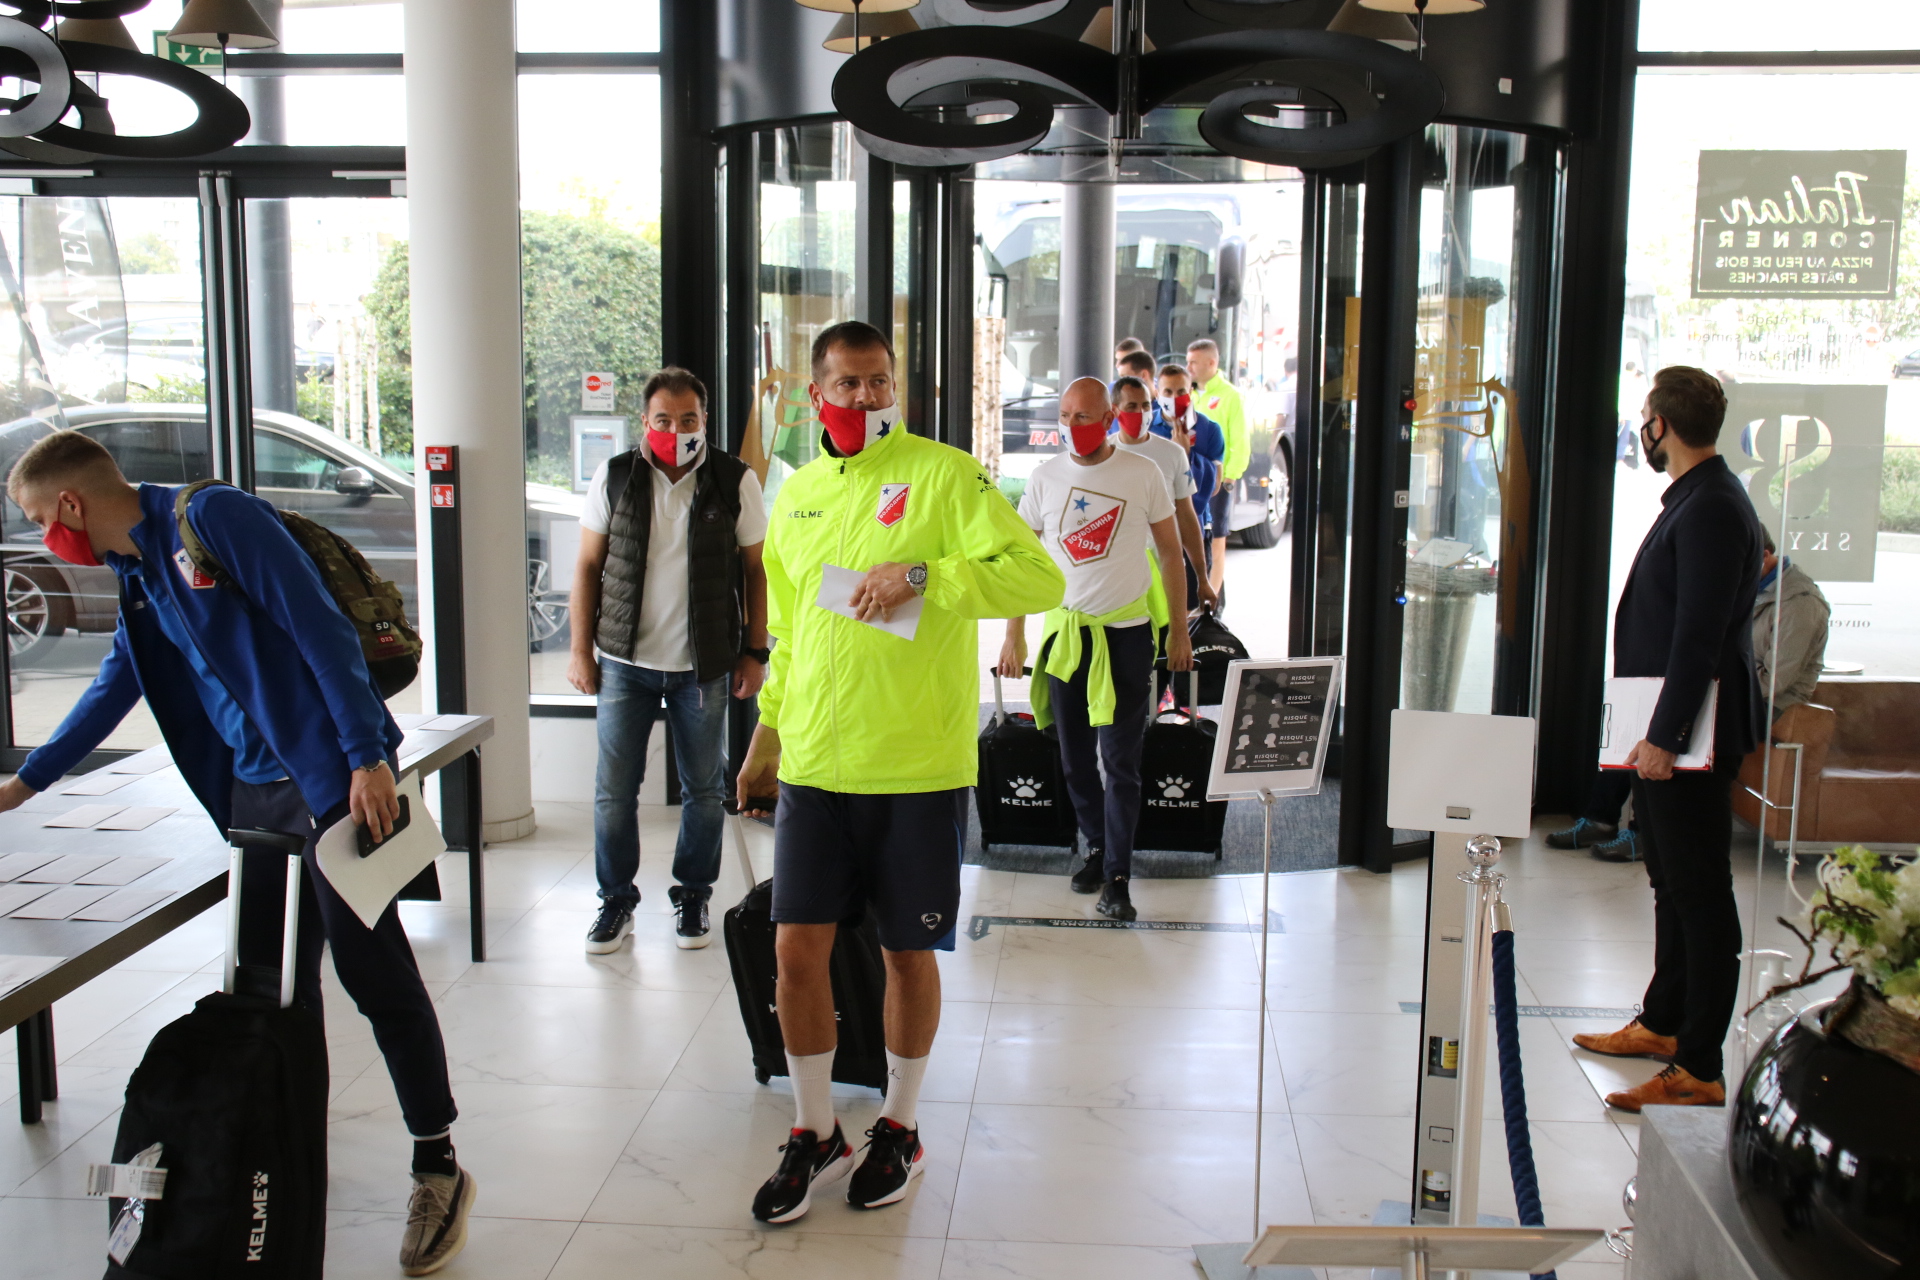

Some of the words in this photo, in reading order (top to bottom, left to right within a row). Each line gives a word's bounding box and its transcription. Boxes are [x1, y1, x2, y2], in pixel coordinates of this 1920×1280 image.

[787, 510, 824, 519] KELME
[1077, 538, 1102, 553] 1914
[375, 621, 389, 631] SD
[1192, 645, 1228, 657] KELME
[1001, 797, 1053, 807] KELME
[1147, 798, 1200, 809] KELME
[246, 1188, 269, 1262] KELME
